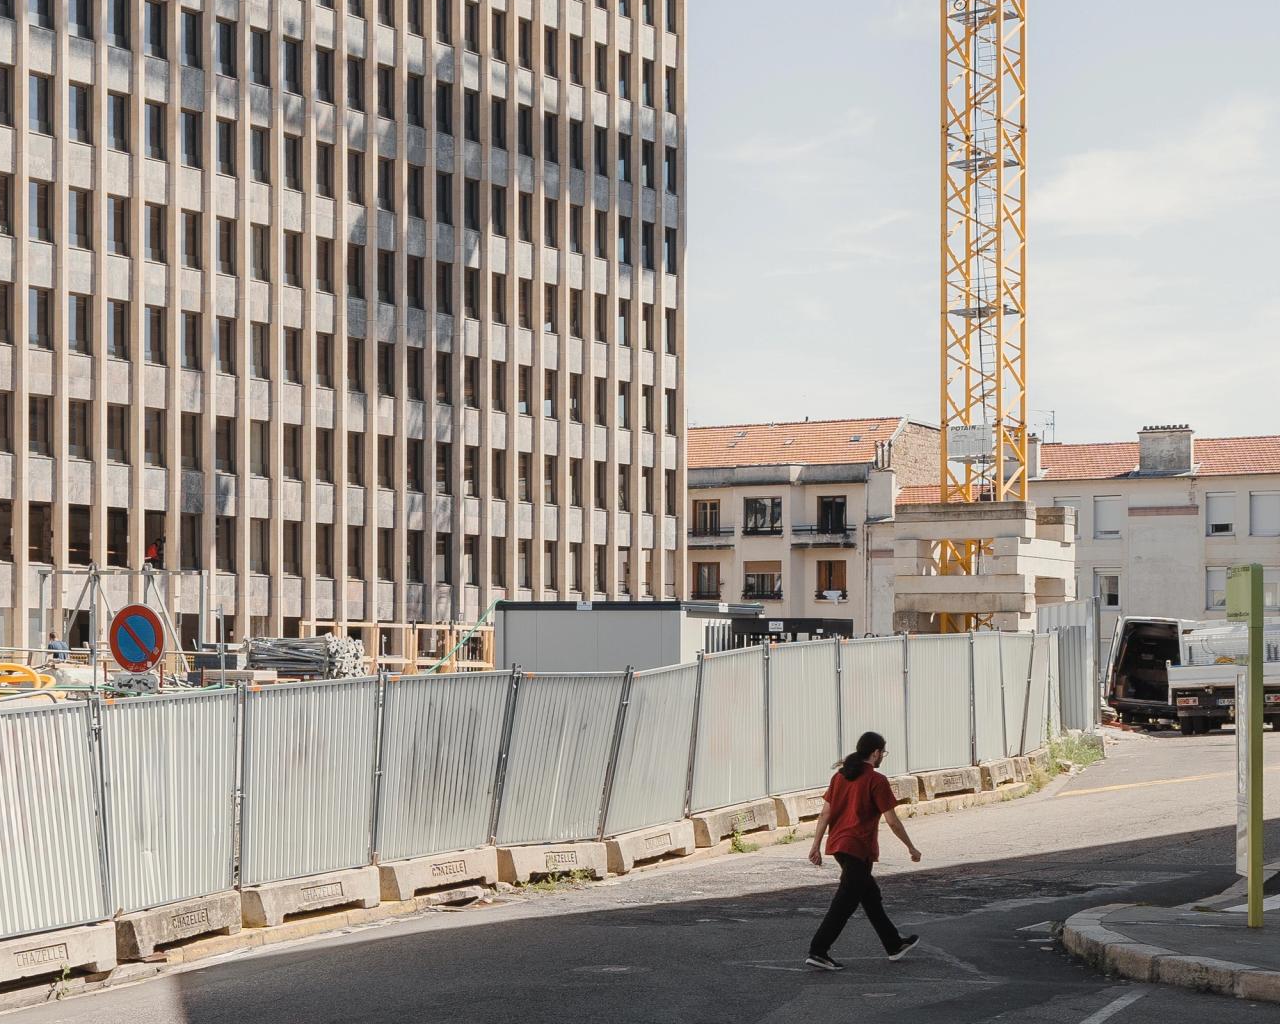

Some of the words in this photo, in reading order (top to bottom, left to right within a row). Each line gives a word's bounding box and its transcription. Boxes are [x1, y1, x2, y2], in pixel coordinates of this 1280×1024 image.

[432, 860, 465, 877] CHAZELLE
[302, 883, 341, 901] CHAZELLE
[172, 909, 206, 929] CHAZELLE
[16, 944, 65, 967] CHAZELLE
